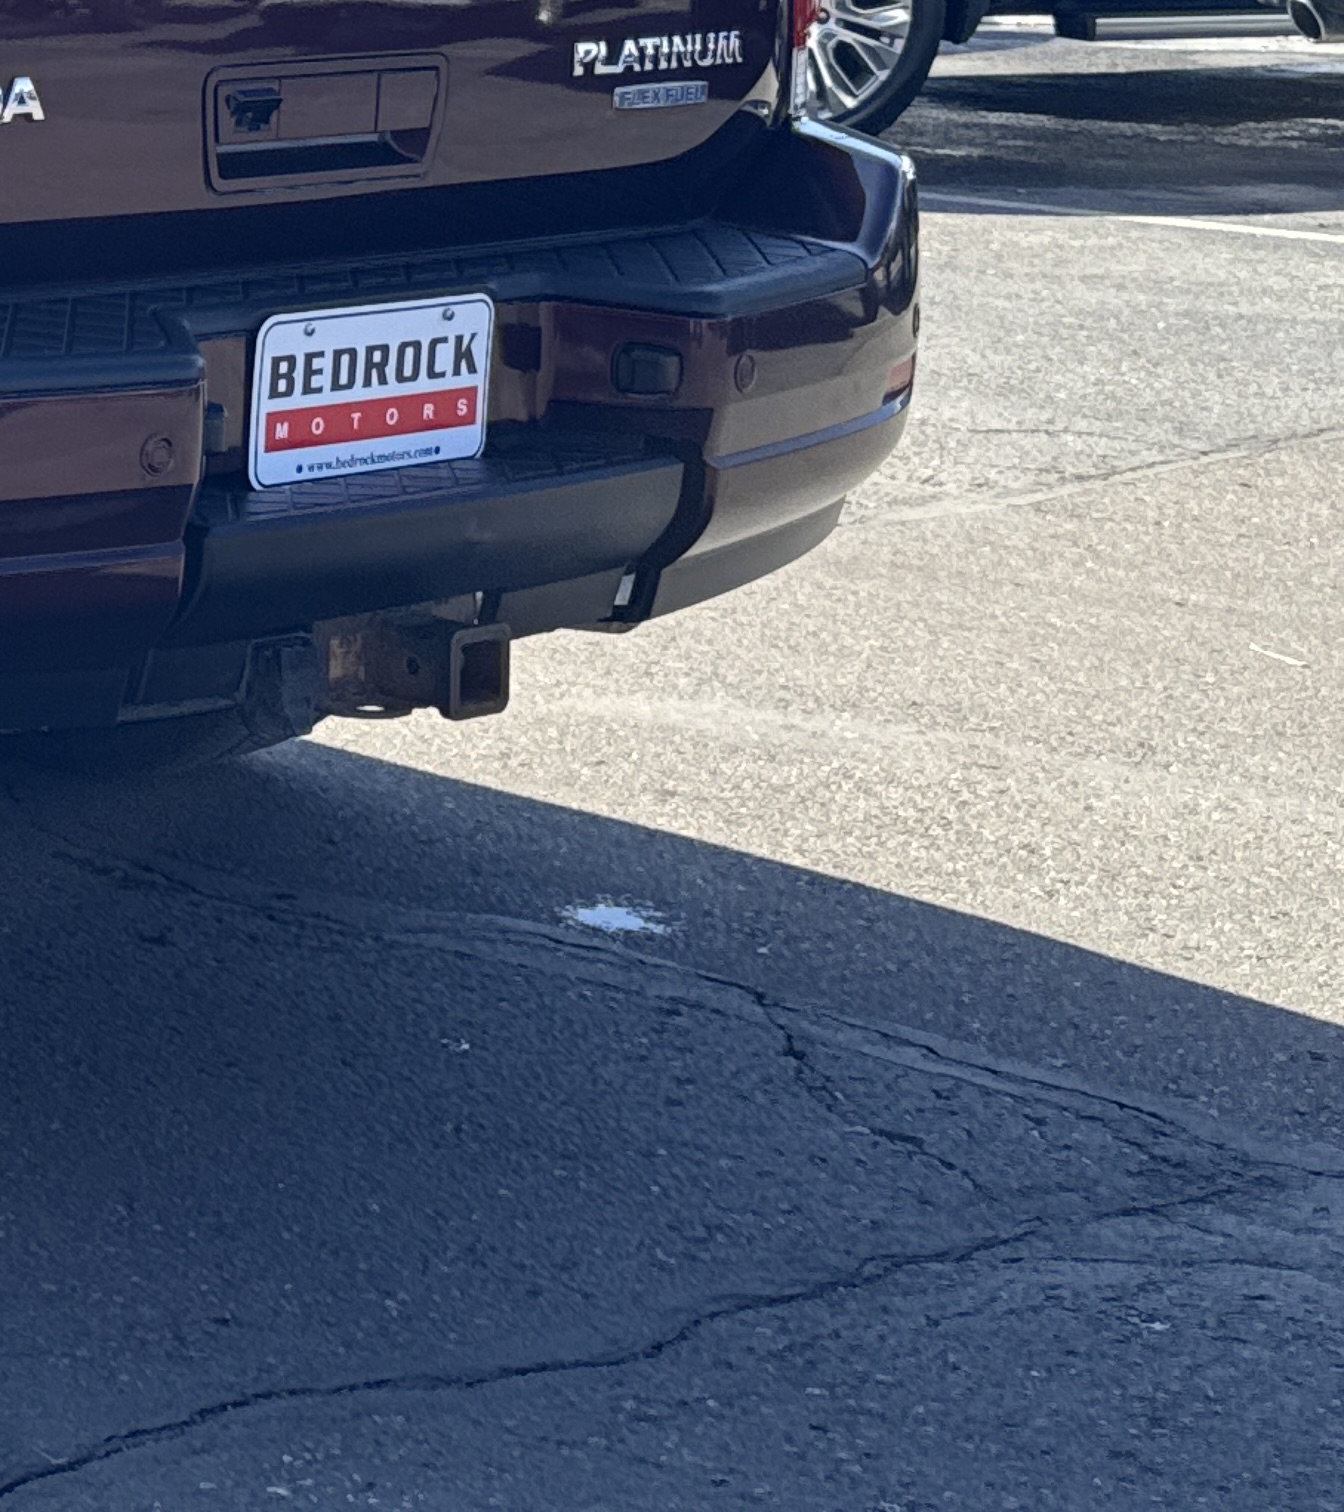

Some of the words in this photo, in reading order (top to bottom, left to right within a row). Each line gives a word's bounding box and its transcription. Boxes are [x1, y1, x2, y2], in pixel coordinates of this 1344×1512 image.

[572, 30, 744, 76] PLATINUM
[622, 90, 662, 106] FLEX
[665, 85, 706, 103] FUEL
[267, 332, 478, 399] BEDROCK
[274, 398, 469, 440] MOTORS
